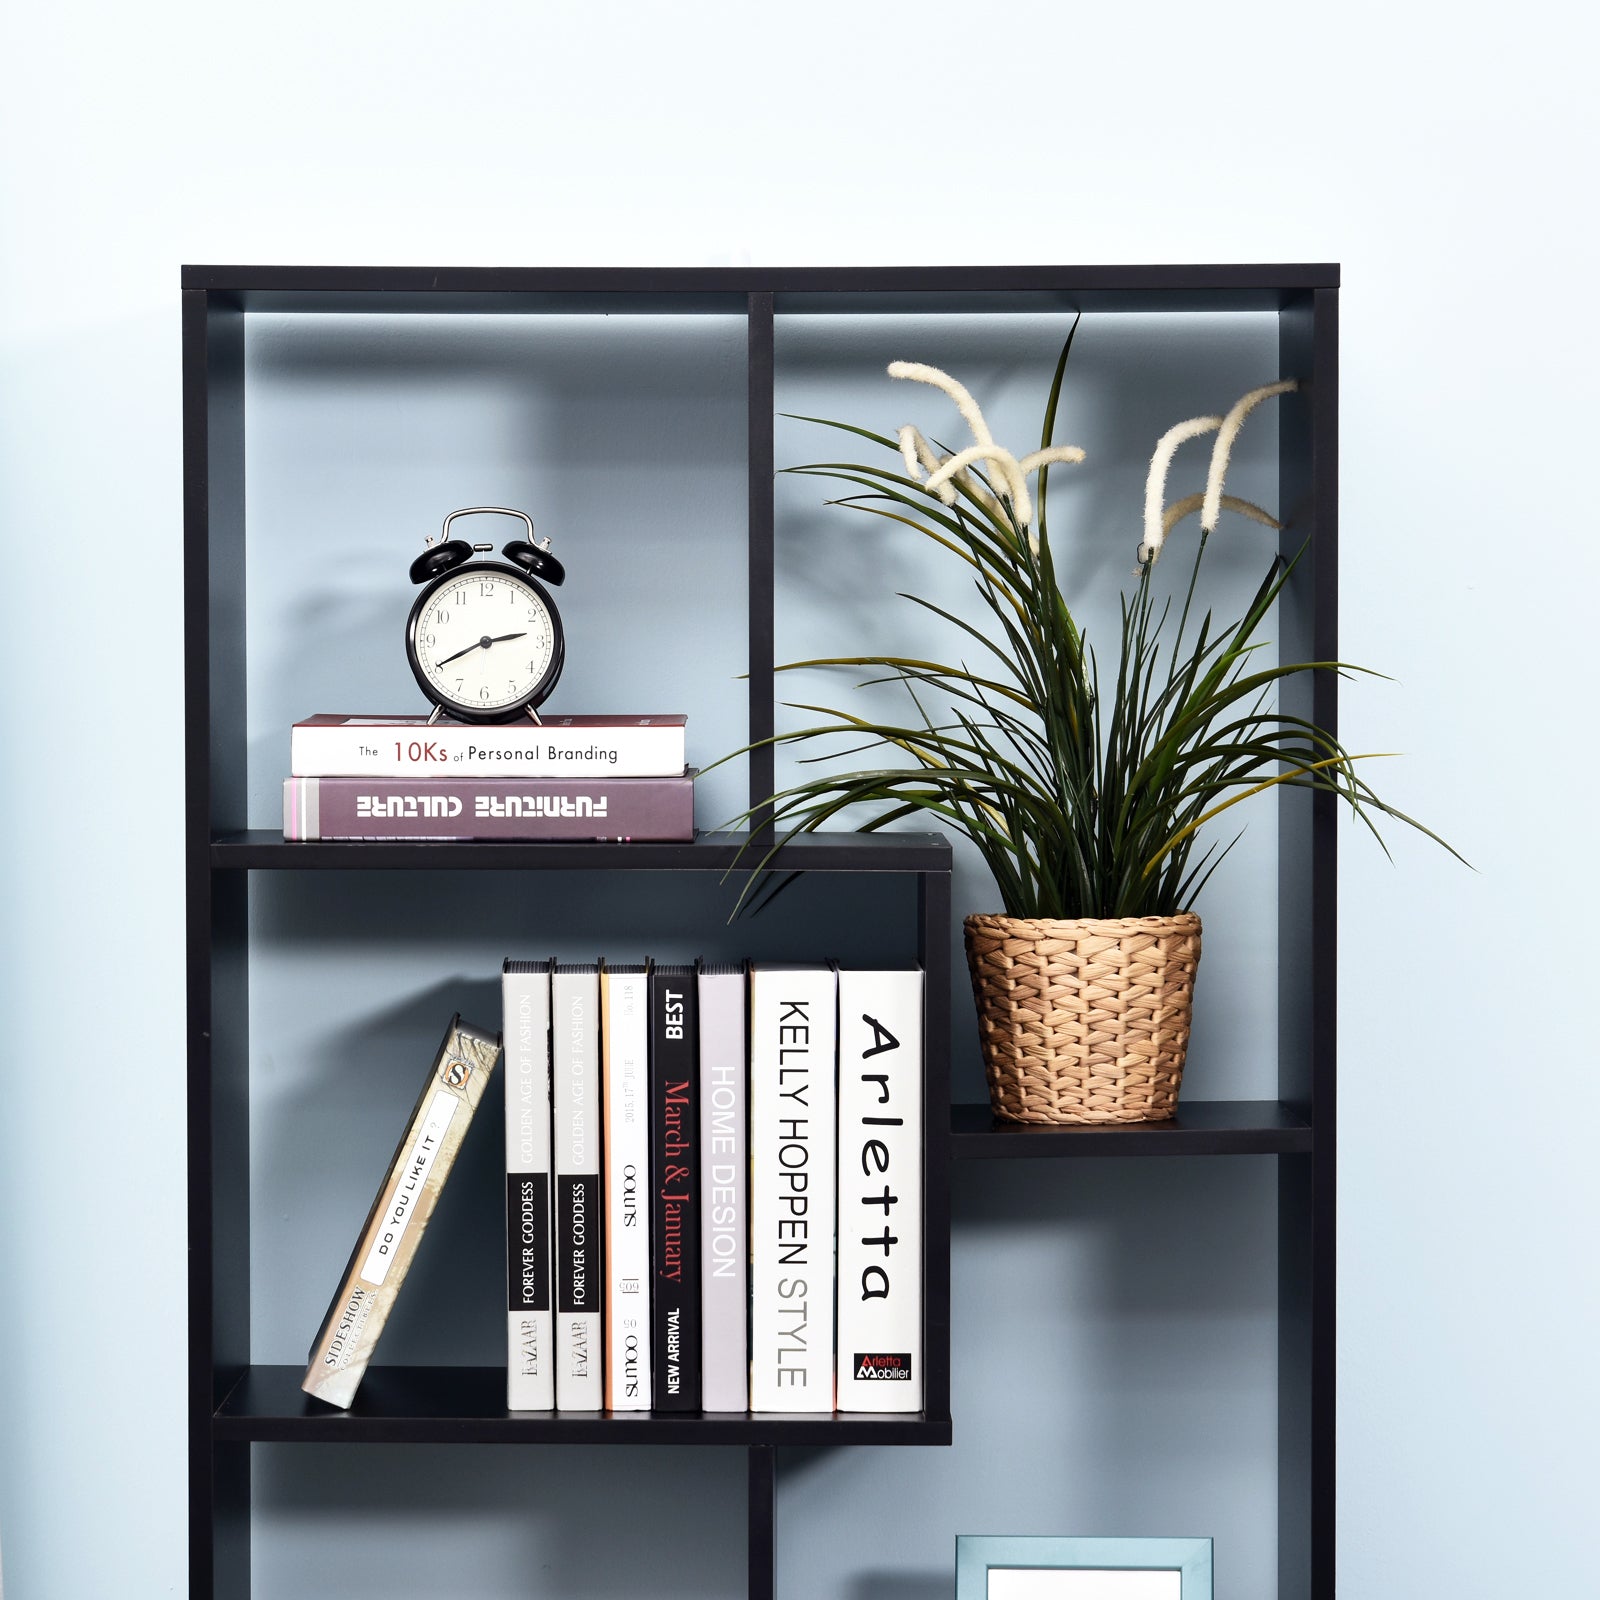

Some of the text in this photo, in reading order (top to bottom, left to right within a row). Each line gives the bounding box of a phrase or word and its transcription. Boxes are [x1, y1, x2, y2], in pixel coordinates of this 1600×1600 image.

[455, 591, 466, 605] 11
[480, 583, 494, 597] 12
[510, 591, 515, 604] 1
[436, 610, 450, 624] 10
[528, 610, 536, 622] 2
[426, 634, 436, 648] 9
[536, 635, 545, 649] 3
[434, 660, 444, 674] 8
[525, 660, 535, 673] 4
[455, 678, 464, 692] 7
[479, 686, 489, 700] 6
[507, 680, 517, 694] 5
[359, 742, 618, 764] The 10Ks of Personal Branding
[357, 796, 607, 818] FURNITURE CULTURE
[665, 988, 684, 1040] BEST
[519, 993, 533, 1164] GOLDEN AGE OF FASHION
[572, 996, 584, 1166] GOLDEN AGE OF FASHION
[711, 1066, 736, 1155] HOME
[860, 1013, 904, 1302] Arletta
[659, 1080, 690, 1283] March & January
[378, 1233, 394, 1255] DO
[391, 1195, 409, 1225] YOU
[405, 1155, 426, 1190] LIKE
[422, 1135, 435, 1151] IT
[778, 1001, 809, 1388] KELLY HOPPEN STYLE
[521, 1181, 535, 1304] FOREVER GODDESS
[572, 1183, 586, 1306] FOREVER GODDESS
[325, 1286, 366, 1367] SIDESHOW
[667, 1307, 680, 1394] NEW ARRIVAL
[862, 1355, 902, 1367] Arletta
[857, 1366, 909, 1380] Mobilier
